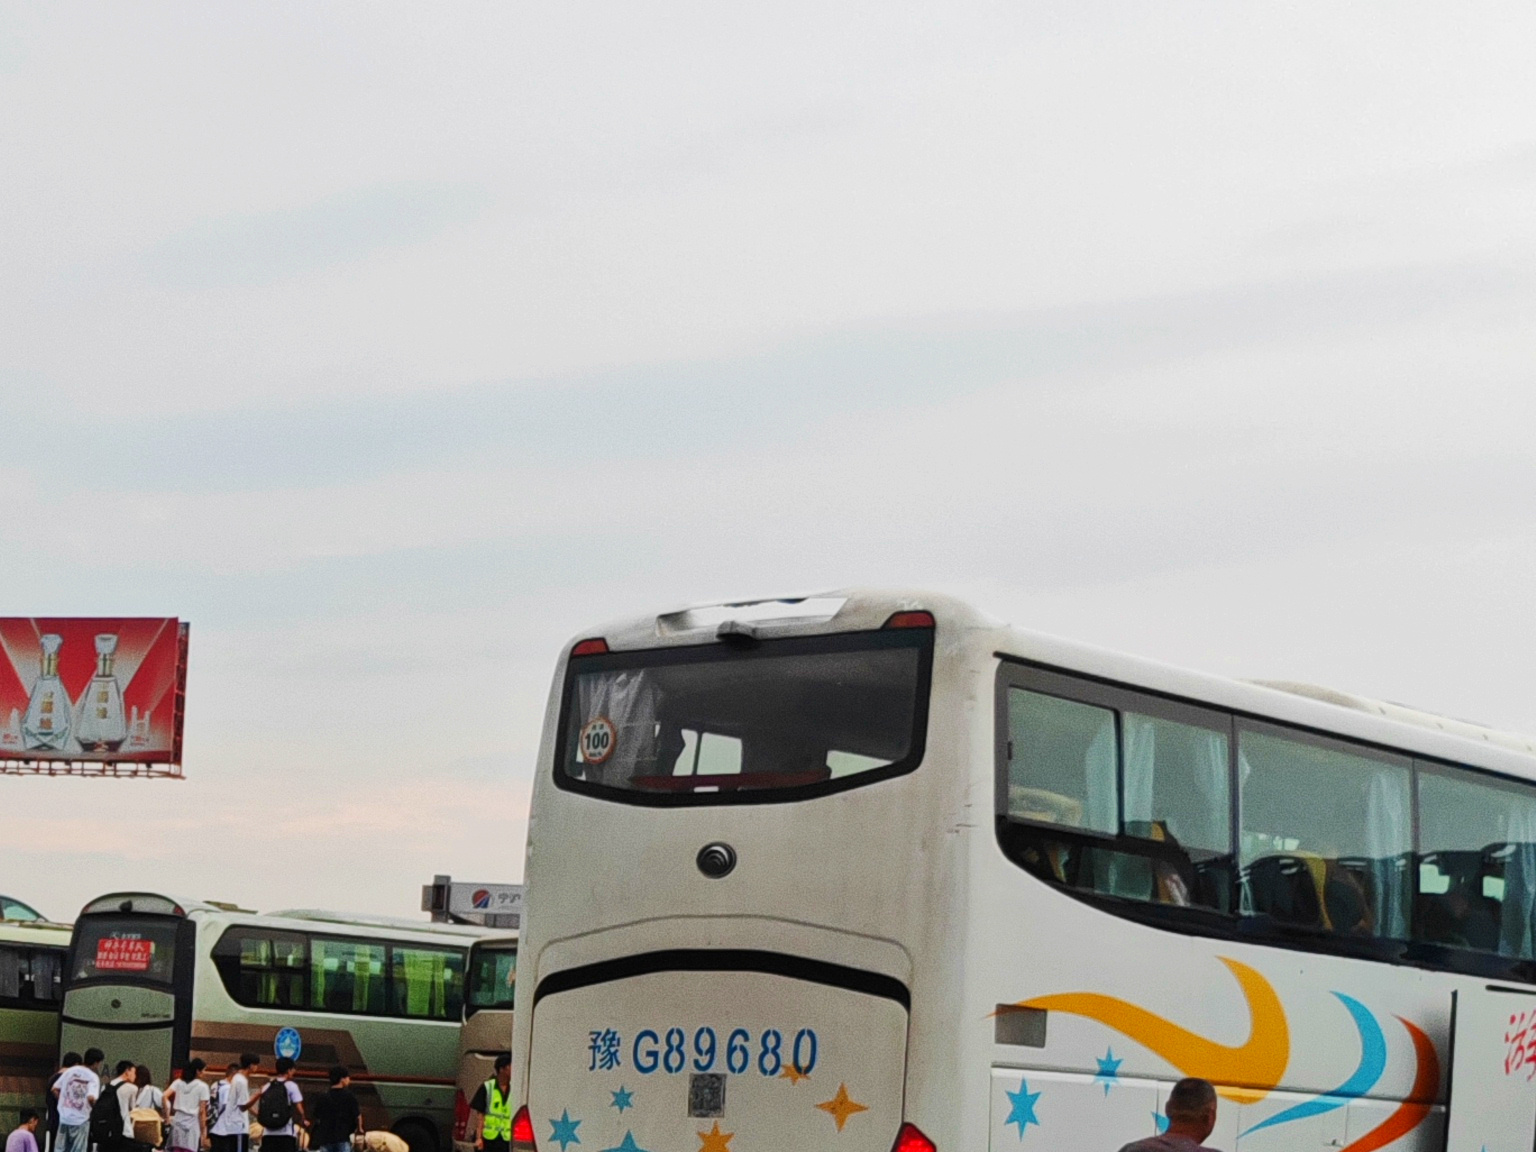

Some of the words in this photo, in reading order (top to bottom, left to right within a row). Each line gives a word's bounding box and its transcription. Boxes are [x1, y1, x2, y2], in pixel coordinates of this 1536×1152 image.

[585, 731, 609, 750] 100
[588, 1028, 621, 1071] 豫
[632, 1027, 817, 1076] G89680
